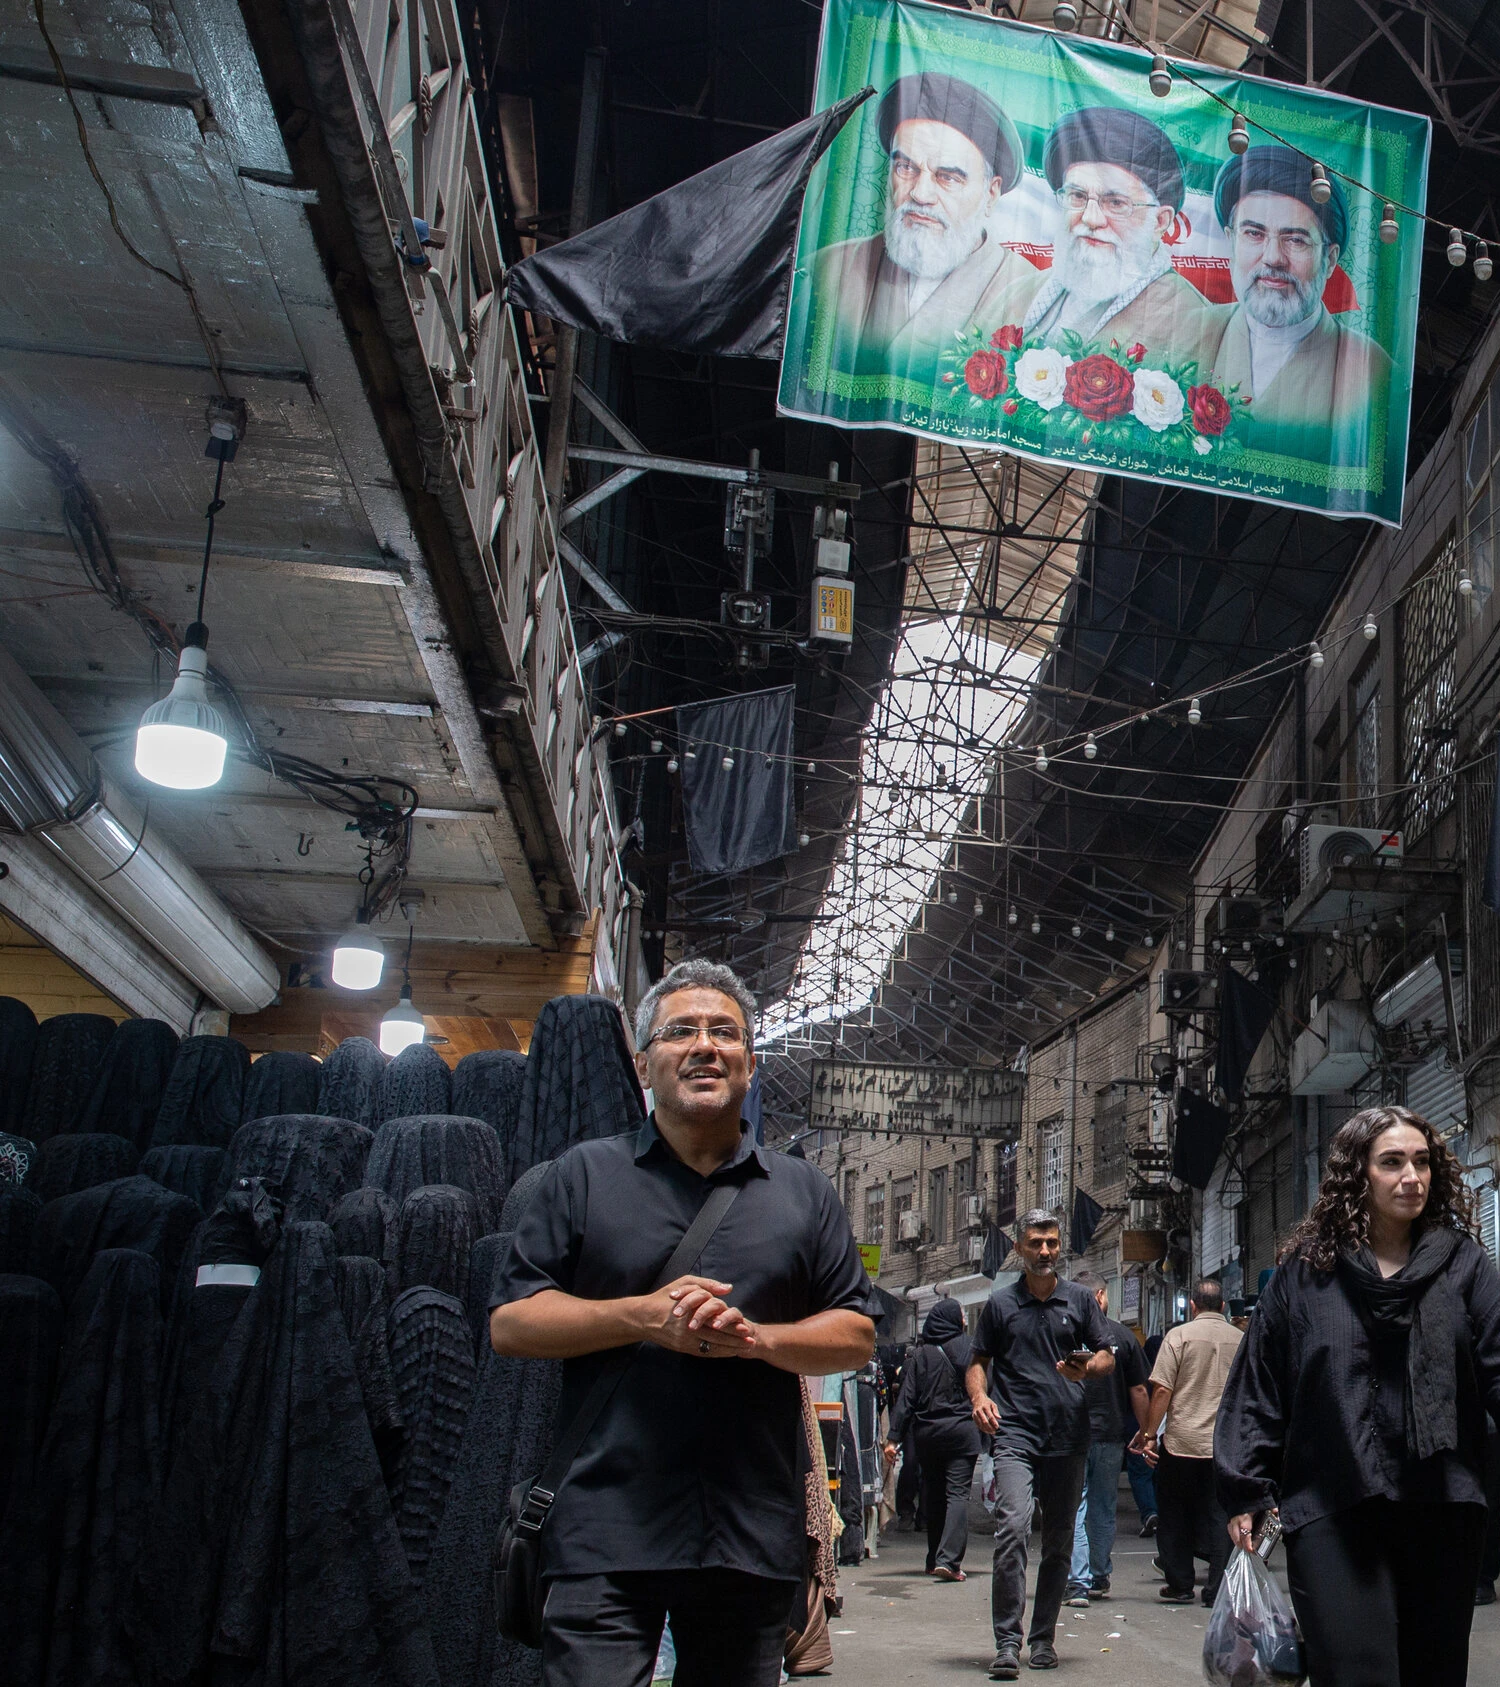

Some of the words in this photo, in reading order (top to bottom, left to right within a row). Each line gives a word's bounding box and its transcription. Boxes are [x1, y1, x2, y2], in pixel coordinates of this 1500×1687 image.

[902, 411, 928, 425] تهران
[929, 417, 949, 433] بازار
[952, 423, 969, 437] زید
[971, 426, 1011, 440] امامزاده
[1011, 433, 1042, 450] مسجد
[1051, 446, 1077, 457] غدیر
[1078, 448, 1117, 464] فرهنگی
[1118, 457, 1149, 470] شورای
[1158, 463, 1190, 477] قماش
[1191, 469, 1217, 482] صنف
[1218, 474, 1252, 488] اسلامی
[1253, 481, 1284, 495] انجمن
